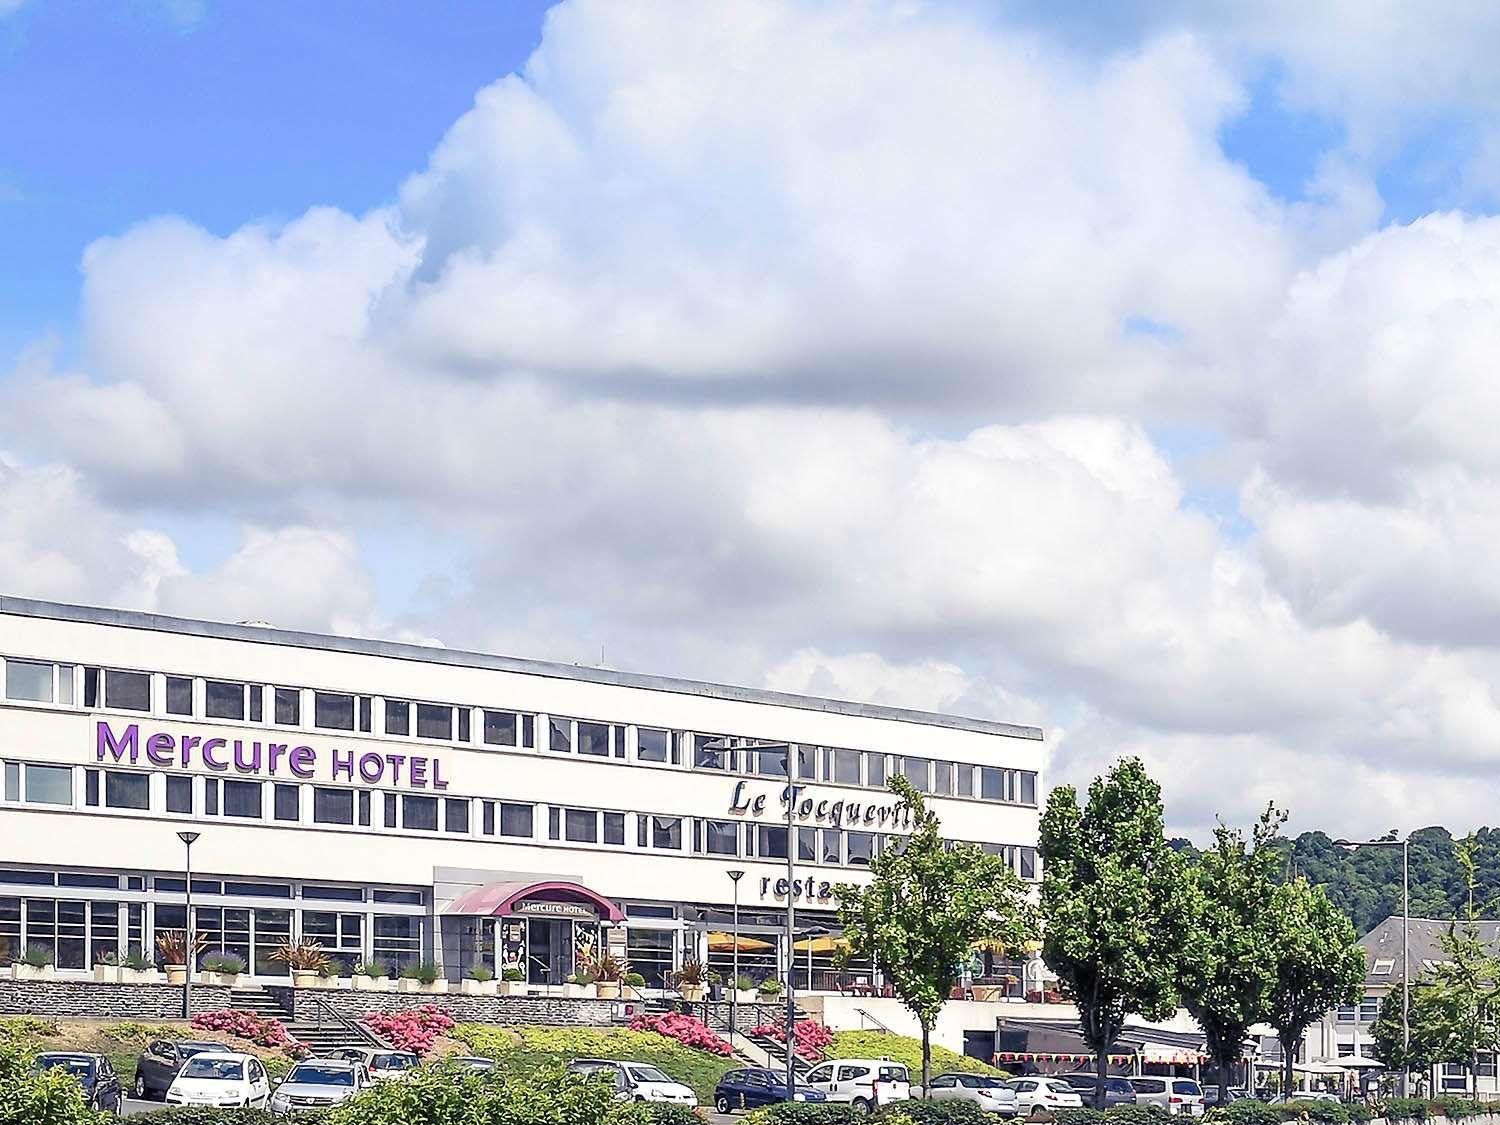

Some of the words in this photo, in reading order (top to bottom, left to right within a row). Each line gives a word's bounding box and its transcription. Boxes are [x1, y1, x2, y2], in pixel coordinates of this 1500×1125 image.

[96, 721, 317, 777] Mercure
[332, 749, 450, 790] HOTEL
[730, 780, 767, 815] Le
[780, 785, 936, 831] Tocquevil
[522, 902, 562, 912] Mercure
